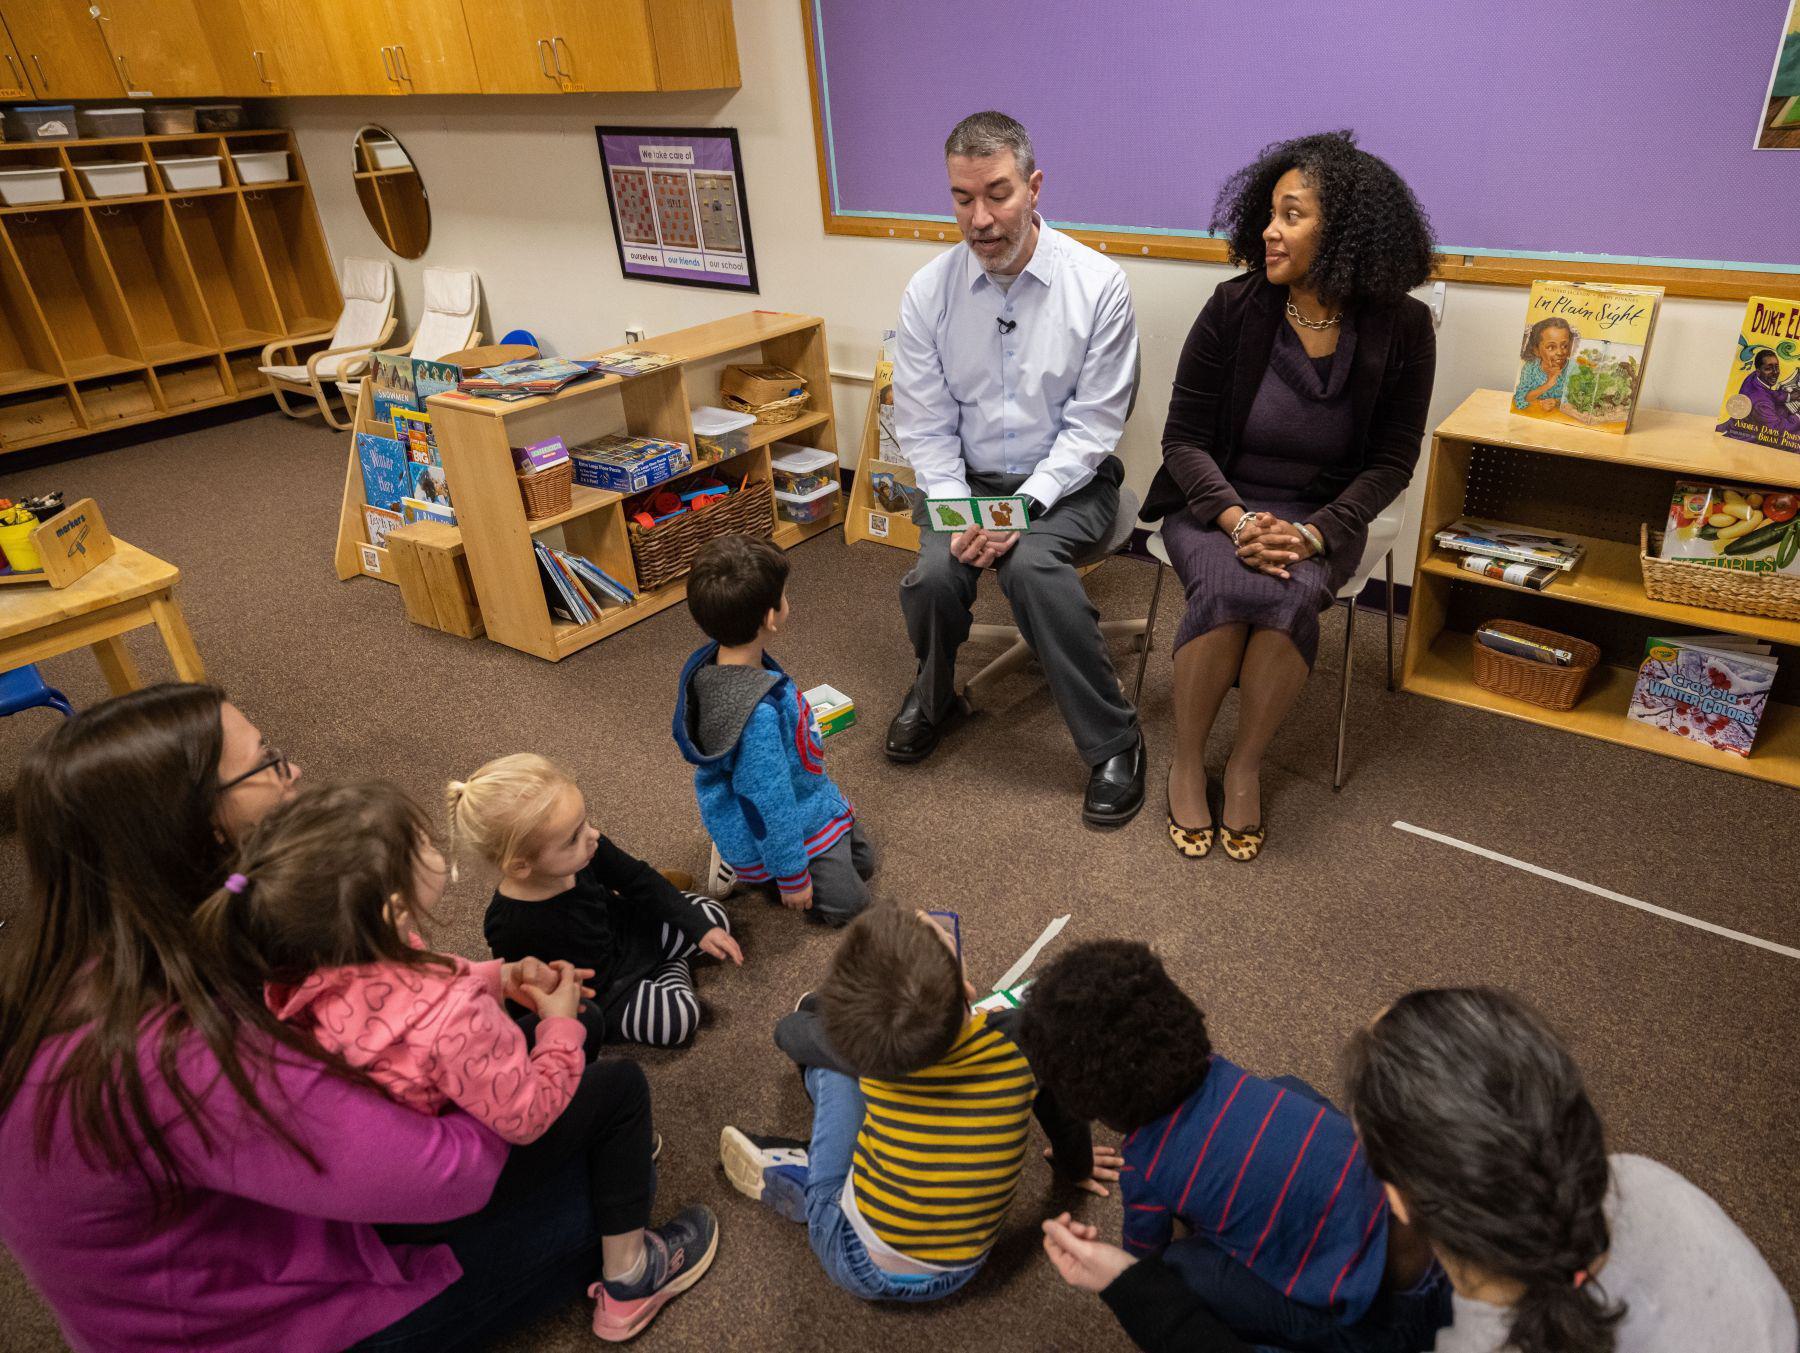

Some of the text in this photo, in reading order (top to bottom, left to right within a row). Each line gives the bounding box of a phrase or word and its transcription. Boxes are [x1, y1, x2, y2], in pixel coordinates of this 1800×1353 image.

[642, 150, 652, 159] We
[653, 151, 667, 159] take
[669, 152, 685, 160] care
[631, 251, 658, 262] ourselves
[679, 257, 700, 267] friends
[710, 260, 744, 271] our school
[1534, 296, 1645, 329] In Plain Sight
[1751, 303, 1785, 337] DUKE
[378, 391, 410, 402] SNOWMEN
[1761, 425, 1779, 436] DAVIS
[1759, 433, 1779, 444] BRIAN
[412, 449, 430, 464] BIG
[56, 514, 86, 538] markers
[1676, 556, 1774, 573] TABLES
[1672, 673, 1738, 704] Crayola
[1649, 679, 1757, 725] WINTER COLORS
